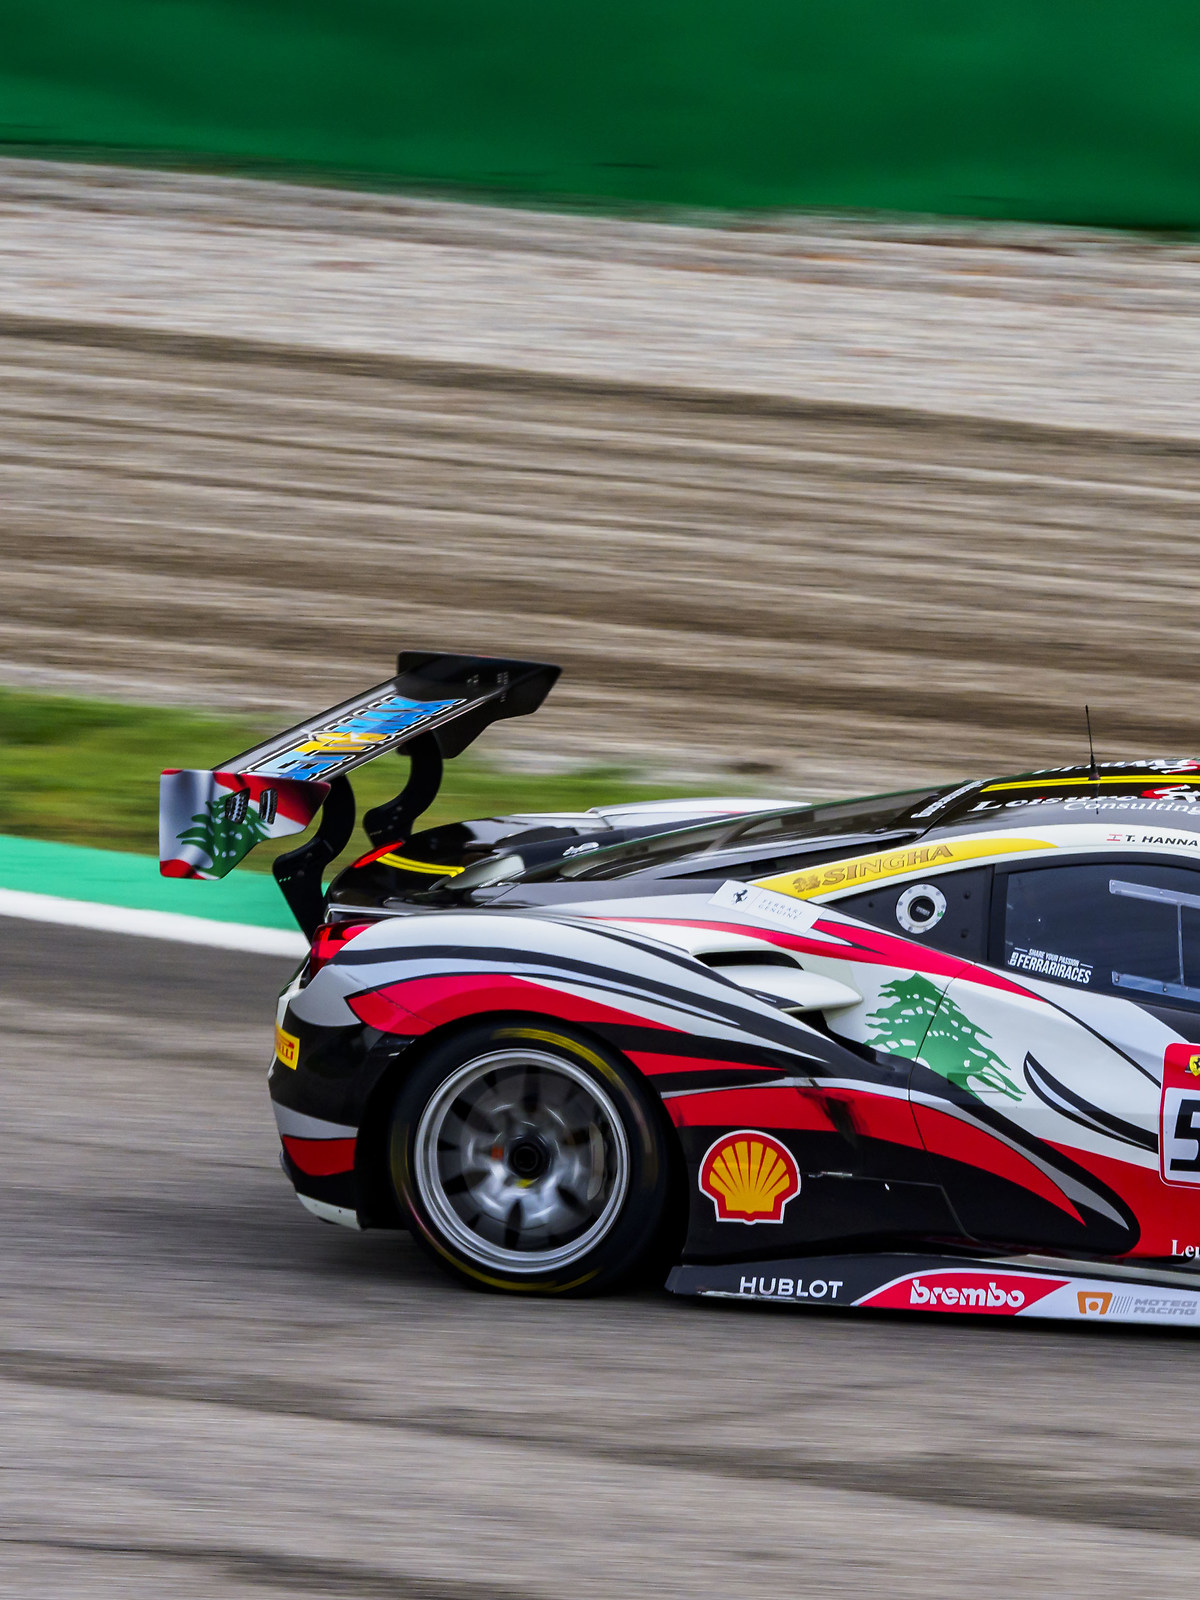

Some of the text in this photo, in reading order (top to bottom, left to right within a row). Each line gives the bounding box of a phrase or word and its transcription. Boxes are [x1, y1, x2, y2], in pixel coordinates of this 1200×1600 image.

[1125, 834, 1199, 847] T. HANNA
[822, 845, 953, 886] SINGHA
[1015, 953, 1092, 984] FERRARIRACES
[739, 1276, 844, 1299] HUBLOT
[909, 1279, 1026, 1308] brembo
[1133, 1306, 1198, 1316] RACING
[1134, 1298, 1199, 1308] MOTEGI
